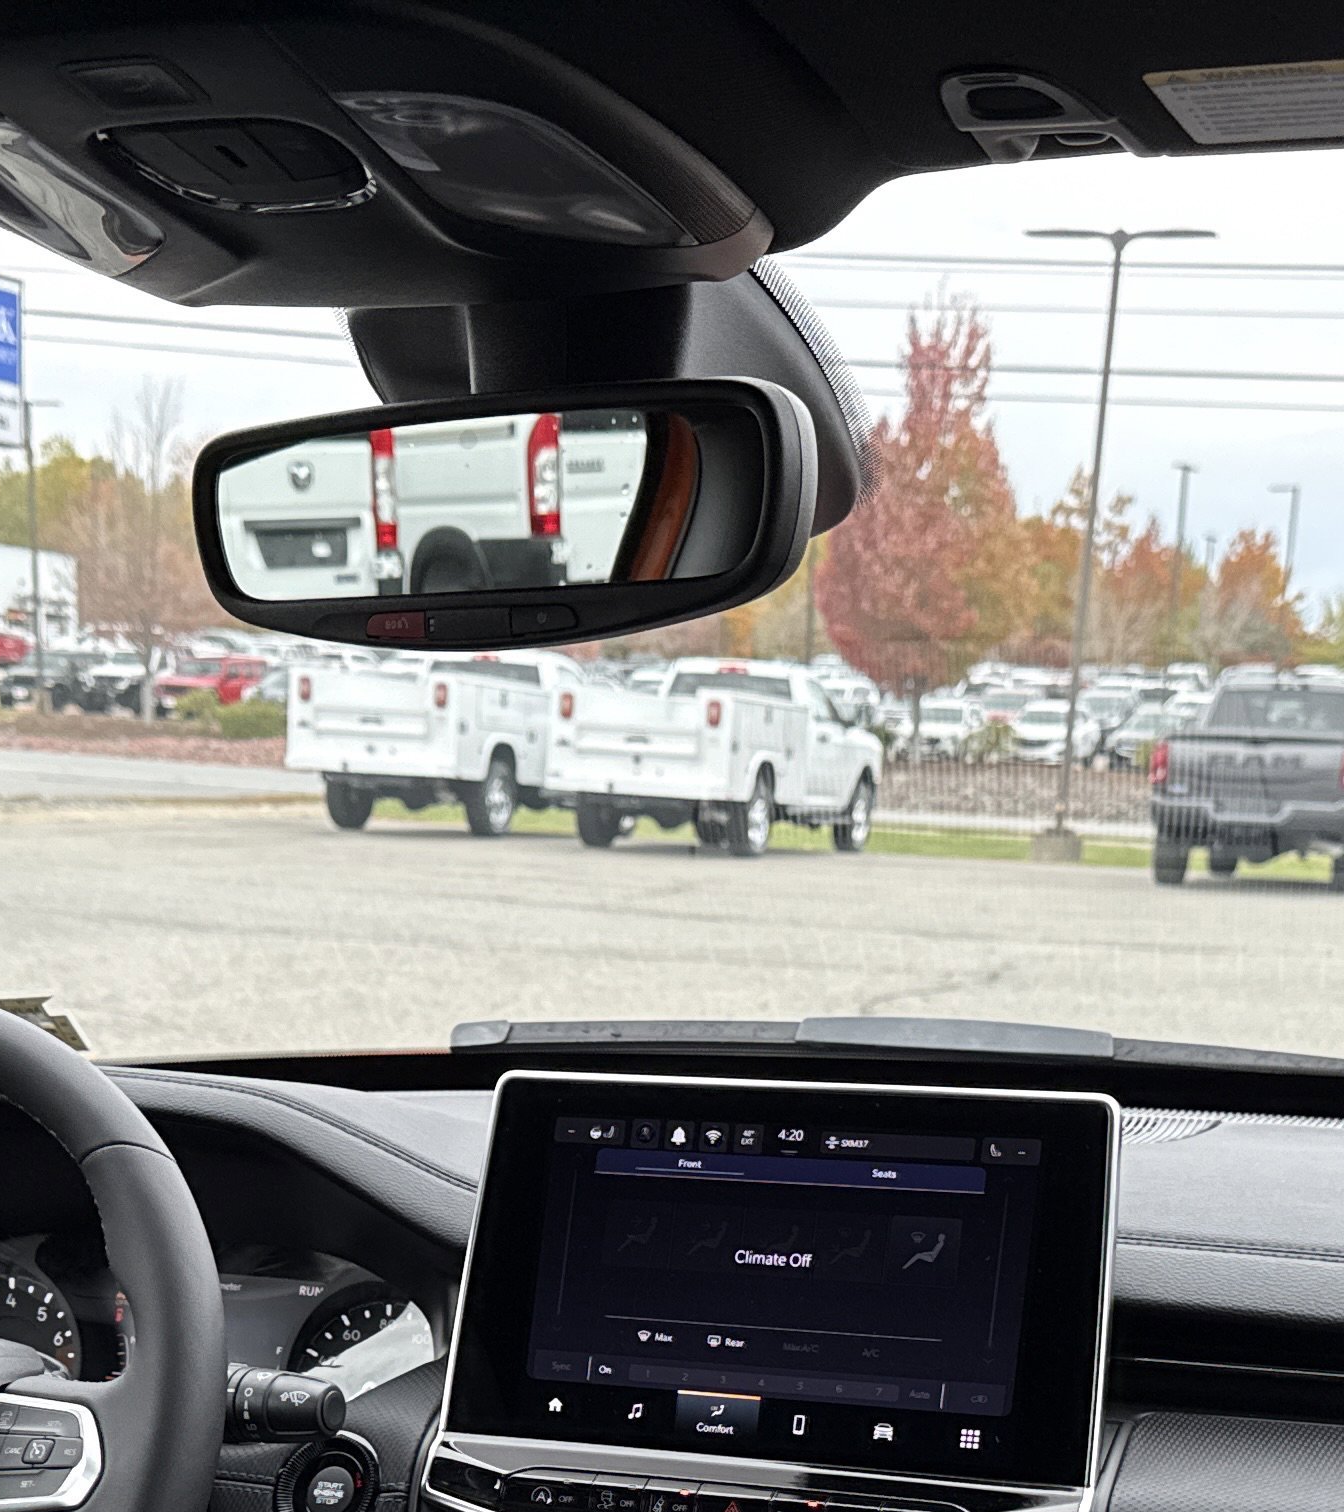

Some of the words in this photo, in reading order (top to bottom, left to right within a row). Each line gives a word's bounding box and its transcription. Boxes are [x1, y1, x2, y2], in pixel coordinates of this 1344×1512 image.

[778, 1128, 804, 1142] 4:20
[678, 1158, 702, 1169] Front
[872, 1168, 897, 1179] Seats
[734, 1249, 786, 1267] Climate
[789, 1252, 813, 1268] Off
[6, 1293, 16, 1308] 4
[36, 1306, 48, 1322] 5
[53, 1331, 64, 1346] 6
[342, 1329, 361, 1342] 60
[412, 1334, 431, 1345] 100
[654, 1332, 673, 1343] Max
[724, 1337, 745, 1348] Rear
[598, 1365, 612, 1375] On
[909, 1389, 931, 1400] Auto
[696, 1421, 734, 1435] Comfort
[316, 1481, 345, 1489] START
[313, 1488, 345, 1499] ENGINE
[558, 1495, 574, 1503] OFF
[315, 1496, 339, 1505] STOP
[619, 1499, 634, 1508] OFF
[672, 1504, 688, 1512] OFF
